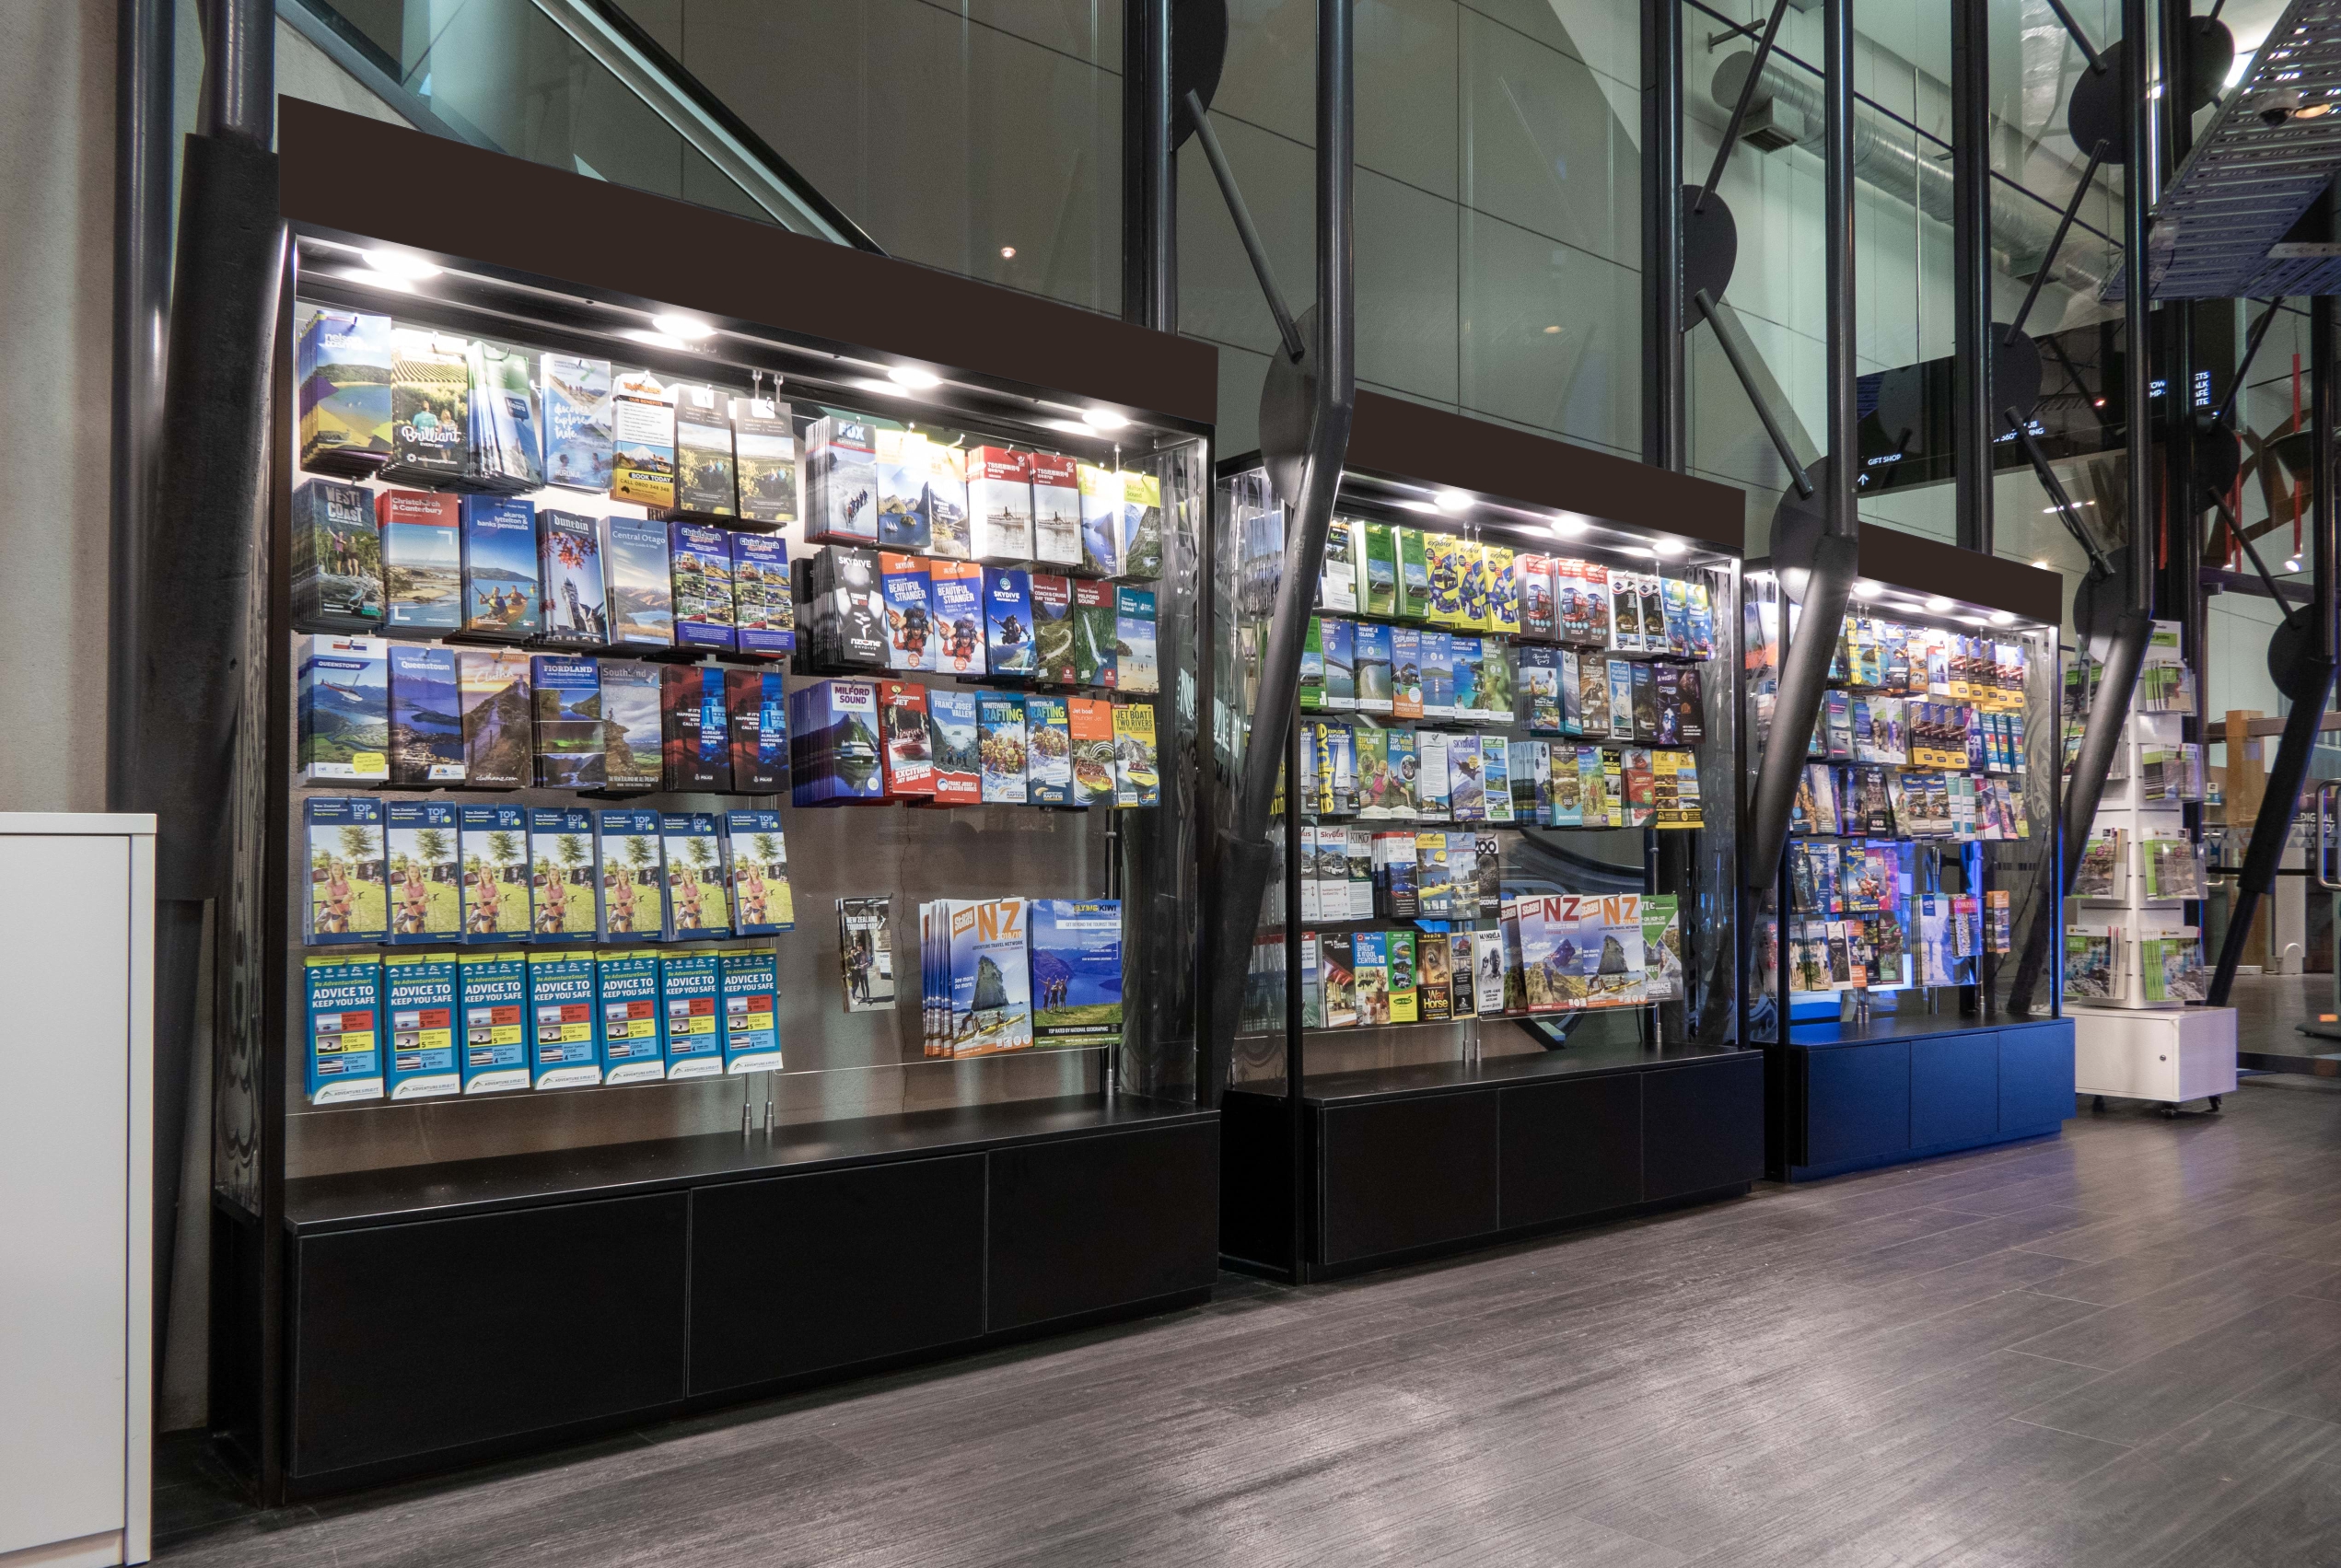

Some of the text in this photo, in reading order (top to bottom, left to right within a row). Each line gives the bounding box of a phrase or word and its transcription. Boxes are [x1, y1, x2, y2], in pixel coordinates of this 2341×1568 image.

[402, 426, 461, 442] Brilliant
[1883, 454, 1902, 463] SHOP
[327, 502, 363, 522] COAST
[400, 505, 443, 515] Canterbury
[553, 514, 589, 531] dunedin
[612, 530, 666, 544] Central Otago
[838, 556, 871, 568] SKYDIVE
[889, 581, 921, 593] BEAUTIFUL
[938, 585, 970, 596] BEAUTIFUL
[895, 590, 926, 601] STRANGER
[943, 594, 974, 604] STRANGER
[994, 591, 1020, 599] SKYDIVE
[318, 661, 360, 669] QUEENSTOWN
[401, 661, 449, 670] Queenstown
[473, 669, 514, 685] Clutha
[834, 686, 870, 696] MILFORD
[839, 695, 867, 704] SOUND
[935, 701, 972, 711] FRANZ JOSEF
[984, 709, 1023, 721] RAFTING
[1031, 707, 1065, 718] RAFTING
[1116, 711, 1147, 720] JET BOAT
[895, 765, 930, 780] EXCITING
[353, 804, 372, 813] TOP
[427, 807, 447, 816] TOP
[567, 814, 583, 822] TOP
[759, 815, 774, 823] TOP
[1543, 897, 1581, 922] NZ
[1603, 897, 1638, 925] NZ
[978, 900, 1021, 941] NZ
[996, 931, 1022, 939] 2018/19
[391, 985, 451, 997] ADVICE TO
[465, 982, 521, 994] ADVICE TO
[534, 981, 590, 993] ADVICE TO
[312, 986, 374, 1000] ADVICE TO
[464, 992, 522, 1004] KEEP YOU SAFE
[534, 993, 554, 1001] KEEP
[555, 992, 572, 1000] YOU
[1428, 990, 1445, 1000] War
[312, 996, 376, 1008] KEEP YOU SAFE
[390, 997, 413, 1006] KEEP
[432, 994, 452, 1003] SAFE
[1424, 998, 1449, 1008] Horse
